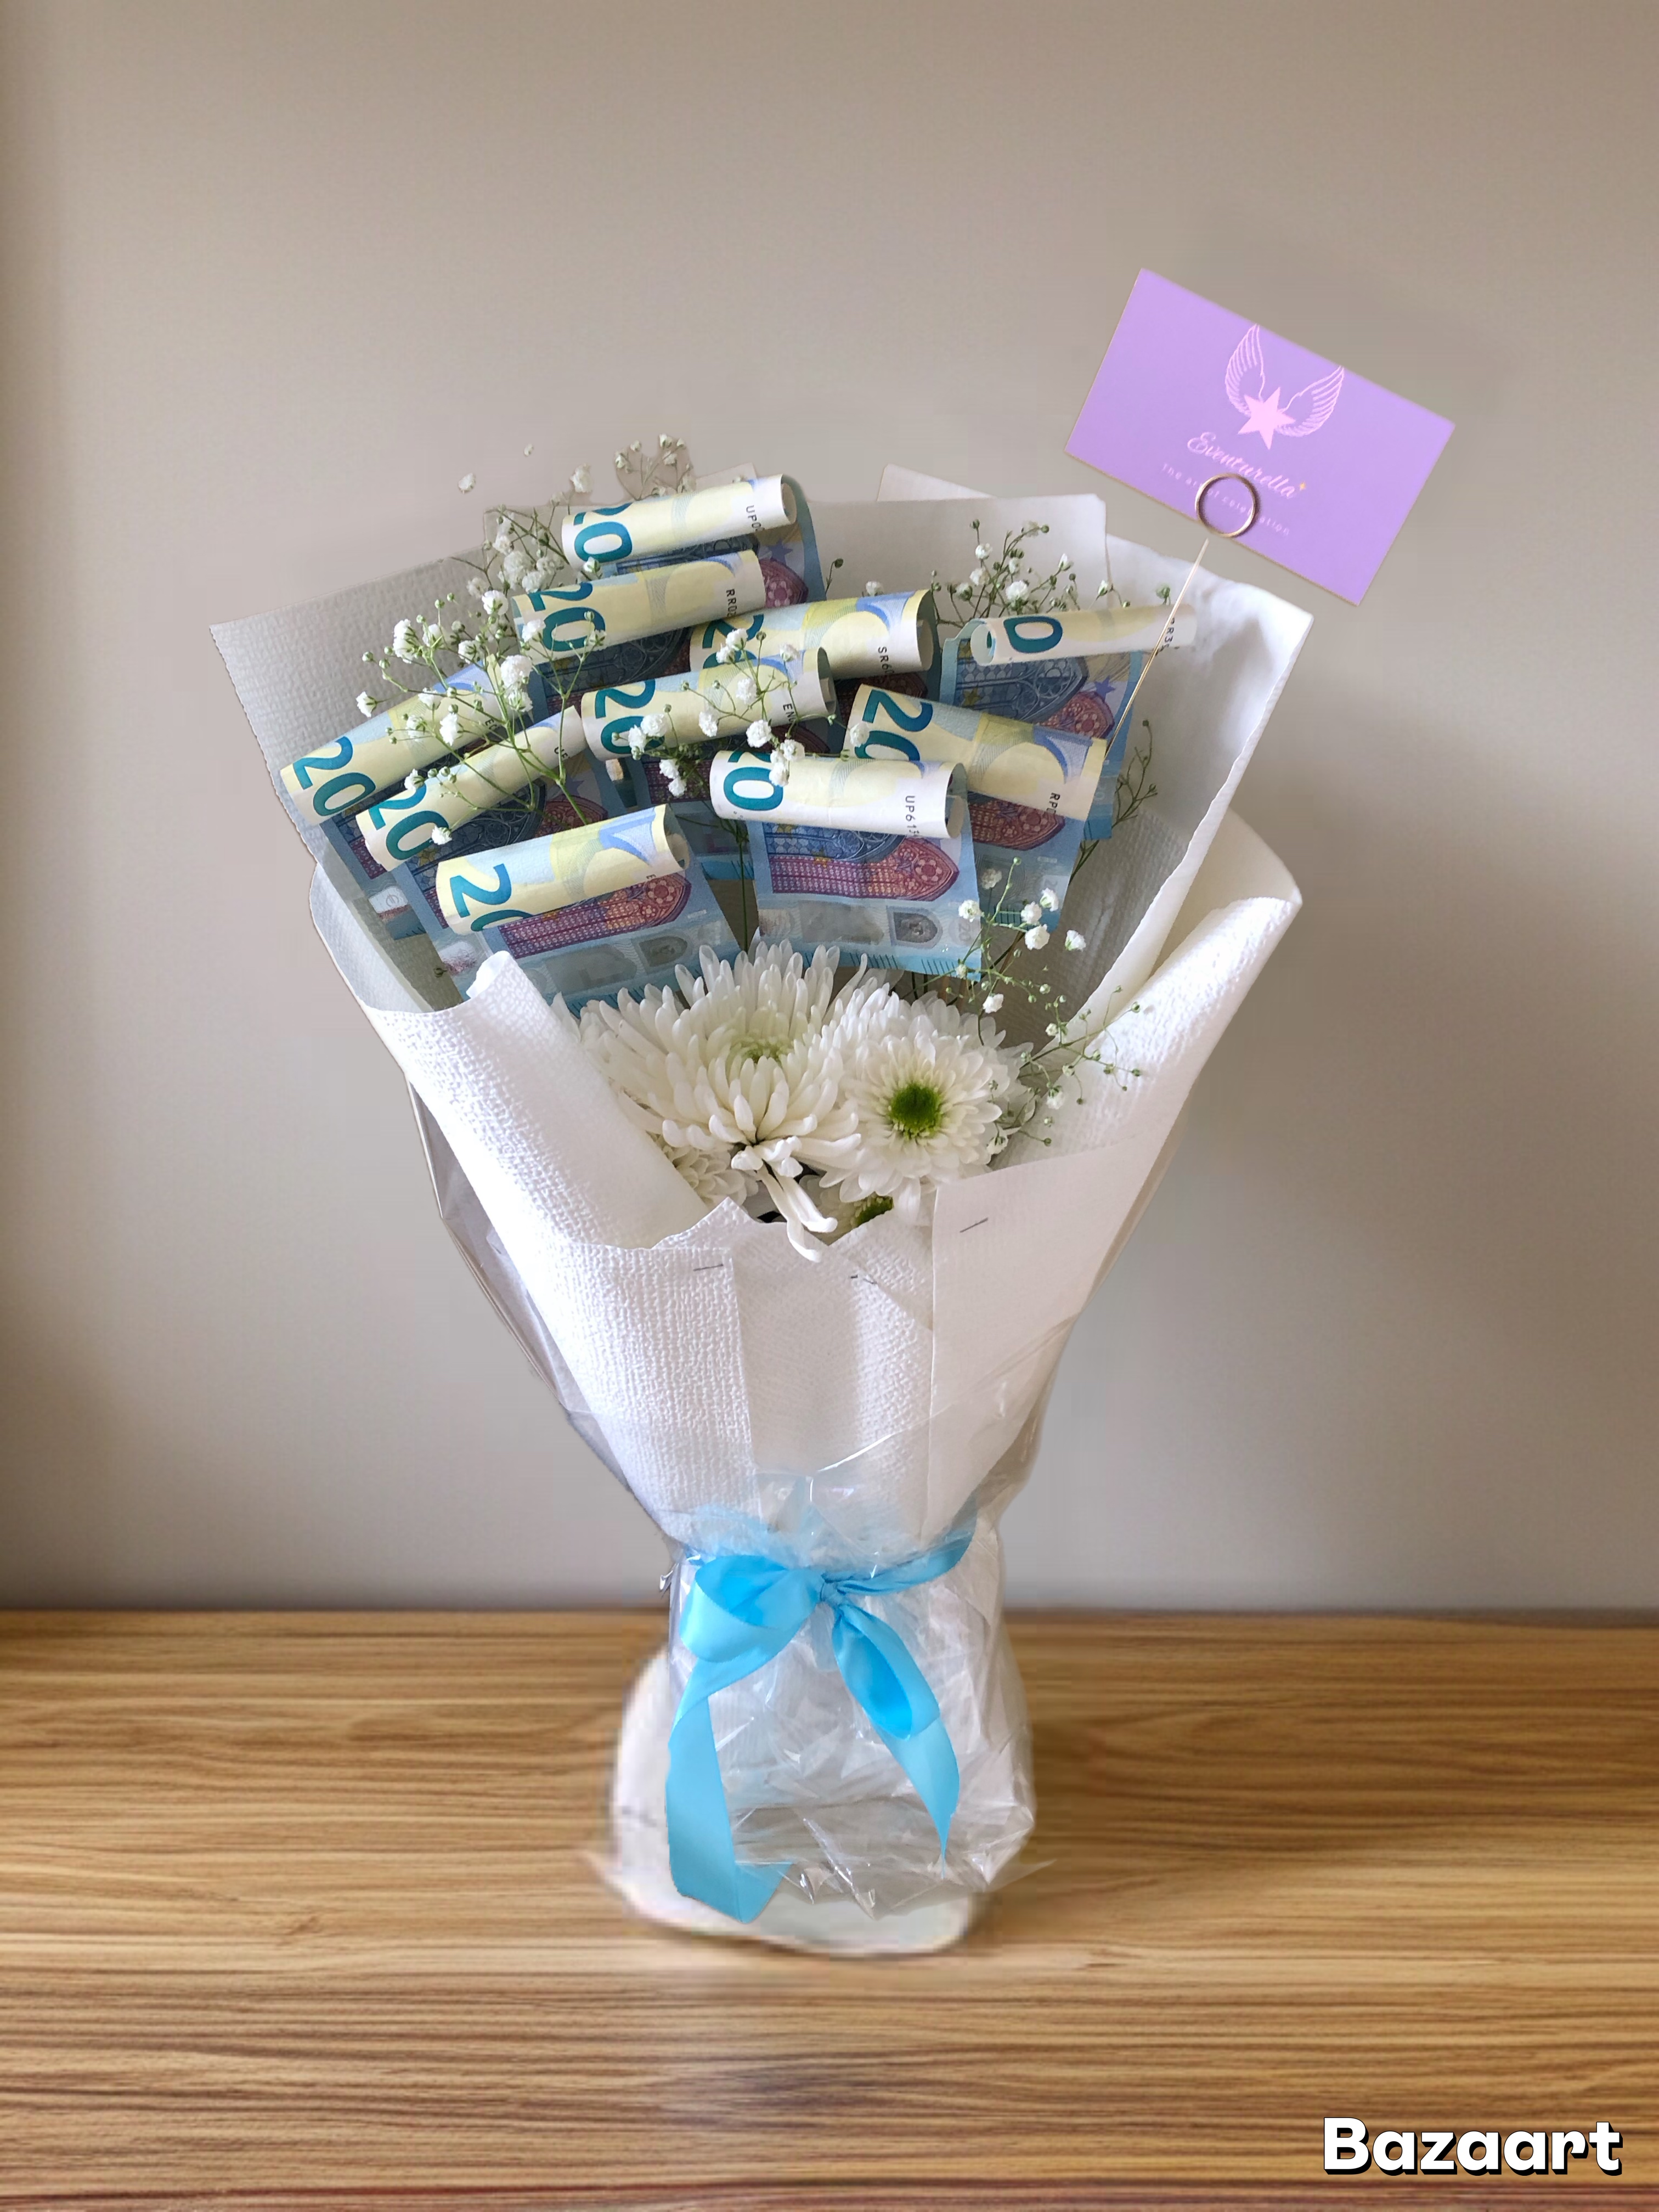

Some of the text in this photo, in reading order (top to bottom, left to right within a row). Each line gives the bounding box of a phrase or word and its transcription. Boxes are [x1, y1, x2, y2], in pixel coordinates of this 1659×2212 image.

[1187, 432, 1296, 499] Eventurella
[292, 736, 376, 817] 20
[368, 781, 450, 860] 20
